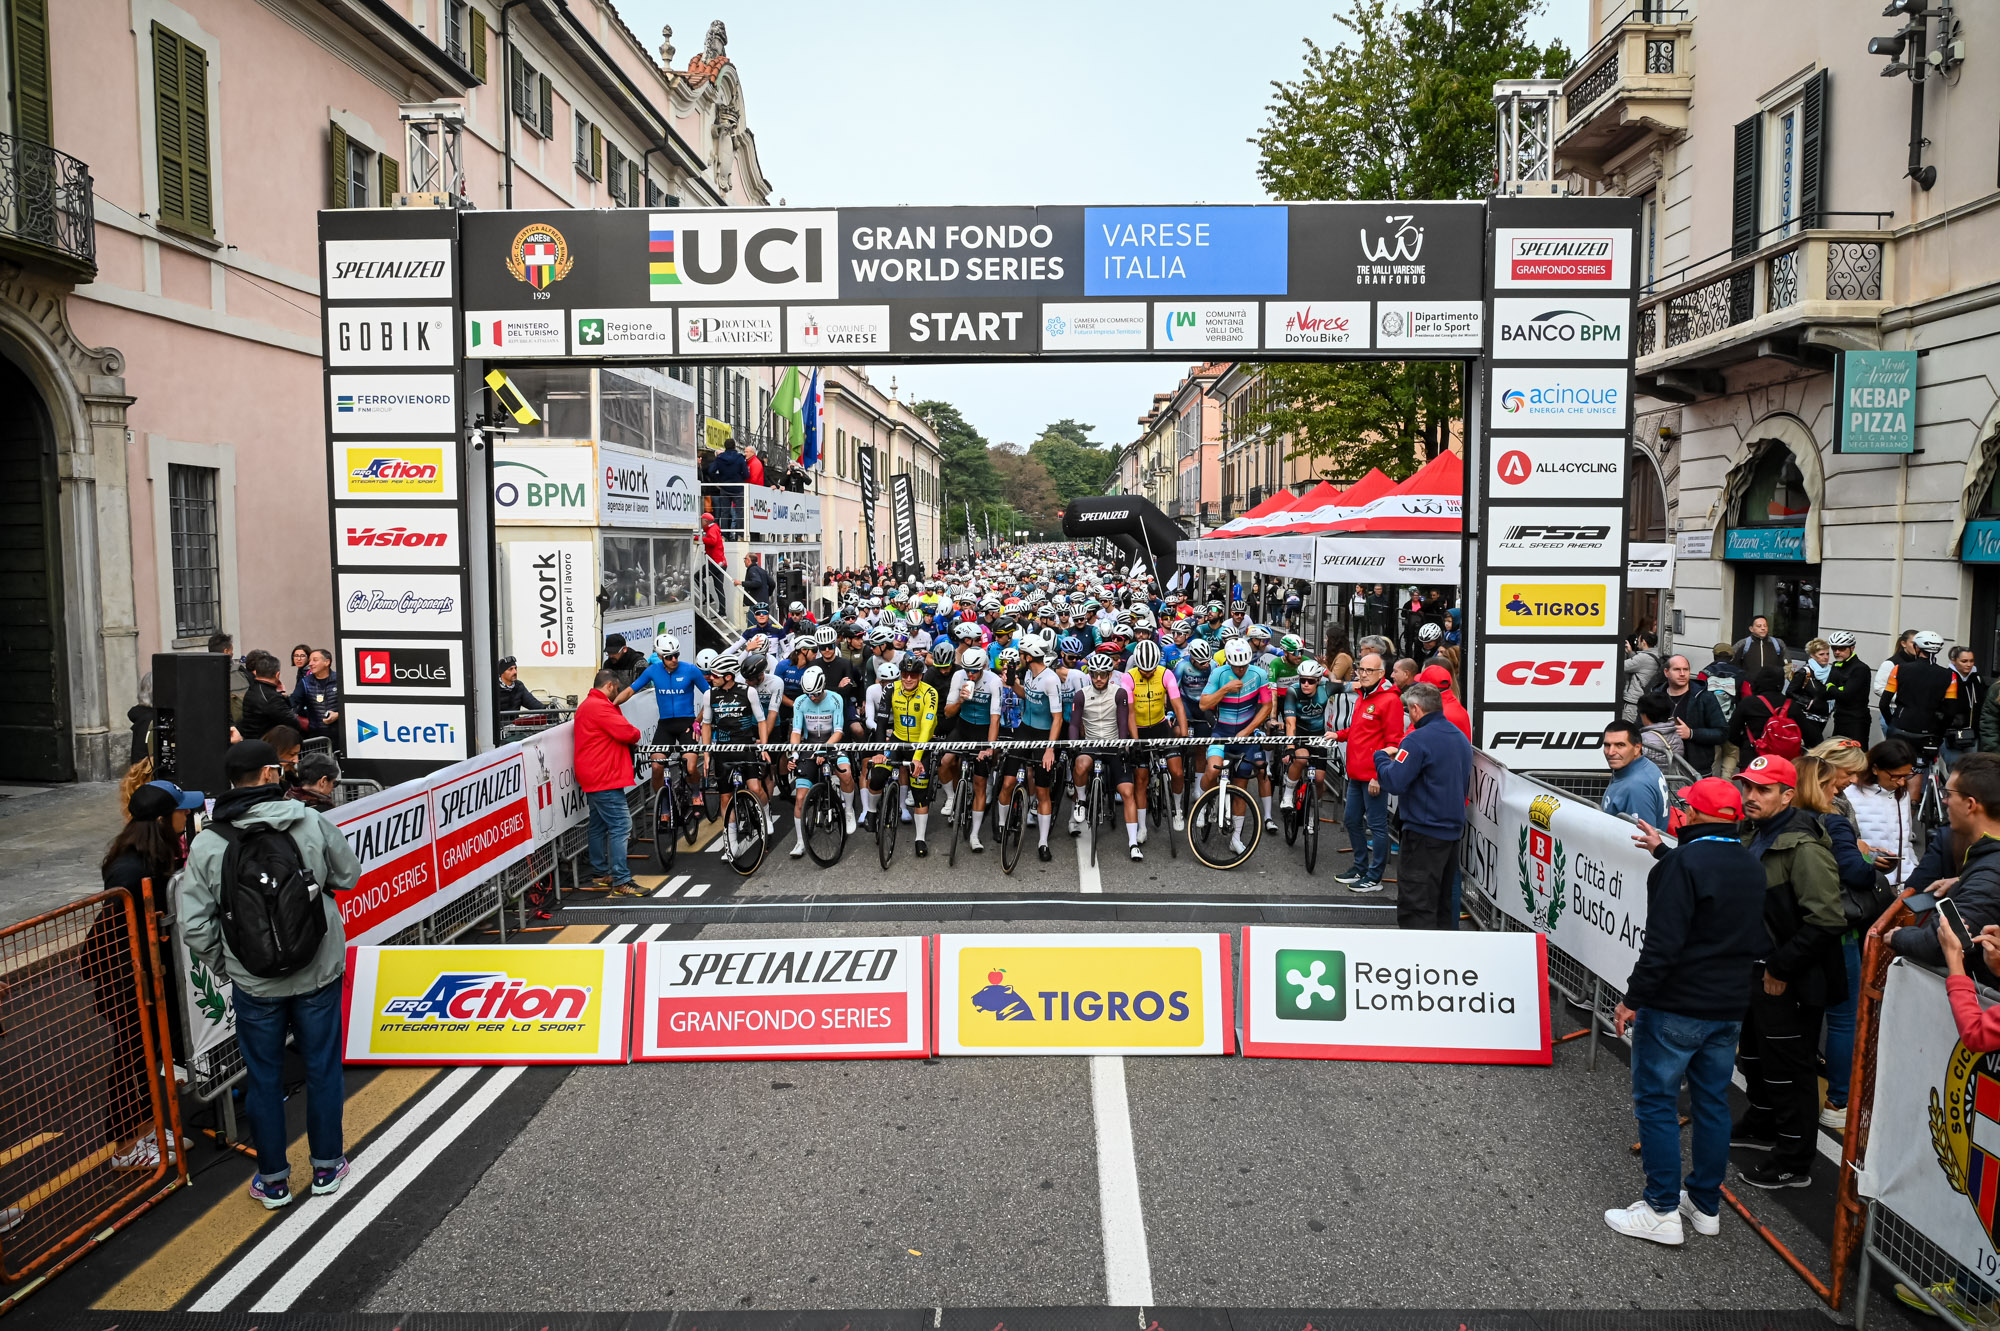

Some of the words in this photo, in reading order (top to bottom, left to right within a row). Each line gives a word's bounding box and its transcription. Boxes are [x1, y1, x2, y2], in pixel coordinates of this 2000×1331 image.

[514, 226, 540, 250] CICLISTICA
[541, 226, 564, 246] ALFREDO
[851, 226, 936, 251] GRAN
[945, 224, 1053, 249] FONDO
[1102, 223, 1211, 247] VARESE
[682, 227, 822, 285] UCI
[1516, 242, 1609, 256] SPECIALIZED
[332, 260, 446, 279] SPECIALIZED
[851, 257, 960, 283] WORLD
[966, 255, 1065, 281] SERIES
[1104, 255, 1187, 280] ITALIA
[1357, 265, 1370, 275] TRE
[1371, 265, 1391, 275] VALLI
[1392, 264, 1426, 275] VARESINE
[1516, 265, 1576, 275] GRANFONDO
[1577, 265, 1606, 275] SERIES
[1357, 275, 1426, 285] GRANFONDO
[533, 291, 551, 300] 1929
[1415, 311, 1479, 322] Dipartimento
[607, 321, 653, 332] Regione
[607, 331, 666, 341] Lombardia
[826, 324, 866, 333] COMUNE
[868, 324, 878, 332] DI
[909, 311, 1024, 343] START
[1415, 323, 1430, 332] per
[1432, 323, 1442, 331] lo
[1444, 323, 1471, 332] Sport
[1501, 324, 1575, 342] BANCO
[1580, 324, 1621, 342] BPM
[339, 321, 431, 352] GOBIK
[721, 330, 773, 343] VARESE
[827, 333, 877, 344] VARESE
[357, 395, 451, 405] FERROVIENORD
[1529, 383, 1617, 404] acinque
[1850, 387, 1911, 409] KEBAP
[1850, 412, 1907, 433] PIZZA
[1536, 462, 1617, 473] ALL4CYCLING
[606, 464, 649, 494] e-work
[527, 482, 585, 508] BPM
[655, 489, 683, 512] BANCO
[683, 493, 696, 513] BPM
[607, 501, 624, 513] agenzia
[624, 503, 632, 513] per
[636, 503, 649, 513] lavoro
[1078, 510, 1130, 522] SPECIALIZED
[1728, 531, 1760, 550] Pizzeria
[1321, 555, 1386, 567] SPECIALIZED
[1398, 553, 1445, 565] e-work
[563, 553, 572, 586] lavoro
[347, 590, 369, 613] Ciclo
[368, 589, 399, 613] Promo
[398, 590, 454, 615] Components
[532, 552, 559, 658] e-work
[564, 597, 575, 613] per
[1535, 602, 1600, 617] TIGROS
[562, 615, 576, 655] agenzia
[394, 663, 447, 680] bollé
[1496, 660, 1605, 686] CST
[383, 720, 455, 744] LereTi
[1224, 736, 1296, 745] SPECIALIZED
[1489, 731, 1604, 750] FFWD
[680, 744, 745, 752] SPECIALIZED
[756, 744, 822, 752] SPECIALIZED
[831, 743, 899, 751] SPECIALIZED
[910, 741, 978, 750] SPECIALIZED
[987, 740, 1056, 750] SPECIALIZED
[1065, 738, 1136, 748] SPECIALIZED
[1147, 737, 1216, 747] SPECIALIZED
[439, 763, 521, 829] SPECIALIZED
[345, 804, 425, 865] IALIZED
[442, 823, 499, 870] GRANFONDO
[500, 811, 525, 840] SERIES
[392, 861, 429, 899] SERIES
[1575, 852, 1605, 893] Città
[1609, 871, 1623, 900] di
[1573, 883, 1616, 936] Busto
[670, 948, 899, 986] SPECIALIZED
[1354, 961, 1479, 991] Regione
[1037, 989, 1190, 1023] TIGROS
[1354, 989, 1517, 1015] Lombardia
[379, 1022, 470, 1033] INTEGRATORI
[475, 1022, 507, 1033] PER
[511, 1022, 534, 1033] LO
[538, 1022, 586, 1033] SPORT
[669, 1009, 816, 1033] GRANFONDO
[821, 1007, 892, 1030] SERIES
[1948, 1086, 1963, 1136] SOC.
